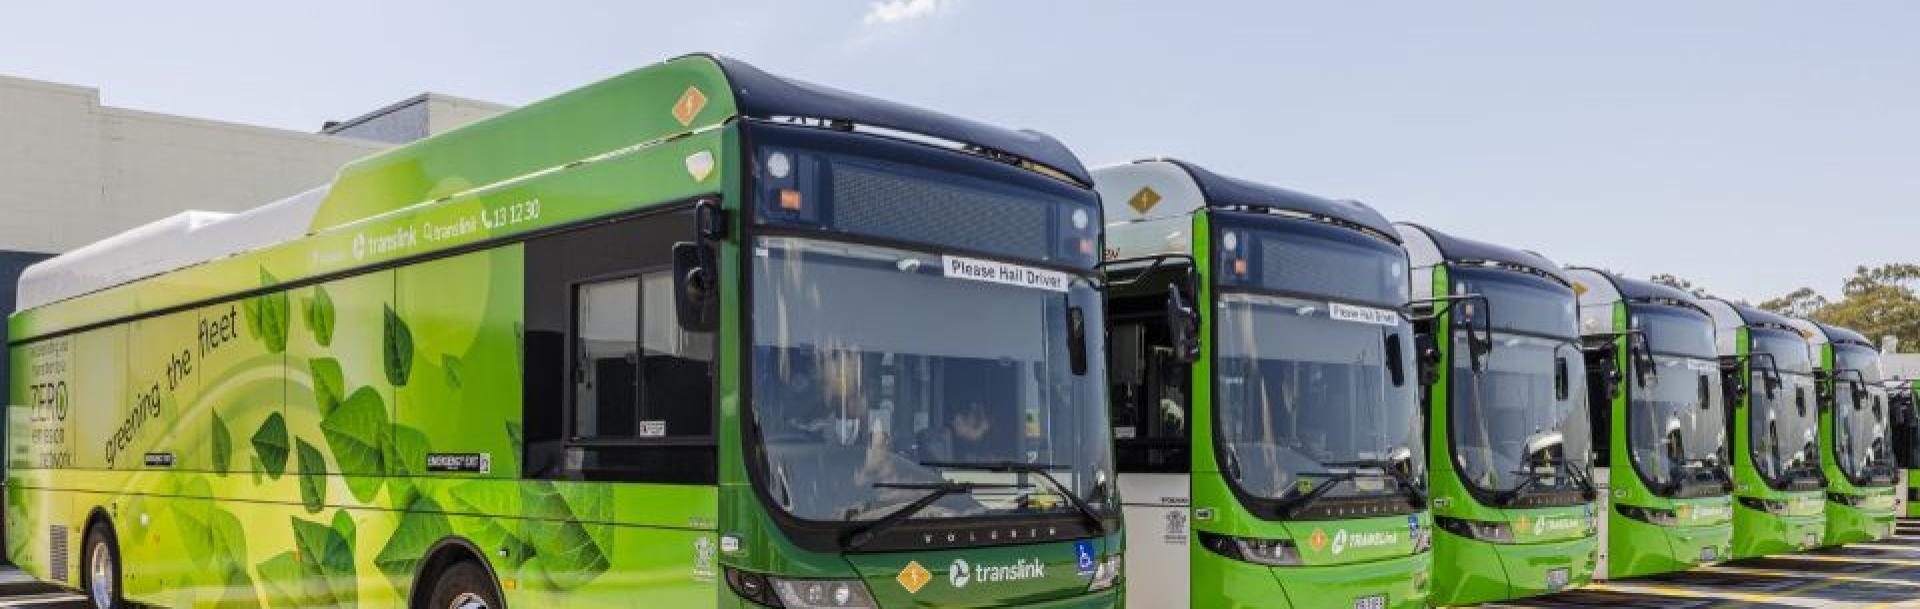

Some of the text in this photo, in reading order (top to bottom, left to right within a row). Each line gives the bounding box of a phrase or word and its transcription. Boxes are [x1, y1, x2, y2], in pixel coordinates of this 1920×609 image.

[494, 199, 541, 228] 13 12 30
[368, 224, 417, 254] translink
[951, 259, 1062, 288] Please Hail Driver
[30, 380, 69, 422] ZERO
[105, 381, 161, 470] greening
[166, 350, 193, 391] the
[199, 305, 238, 359] fleet
[975, 556, 1045, 583] translink
